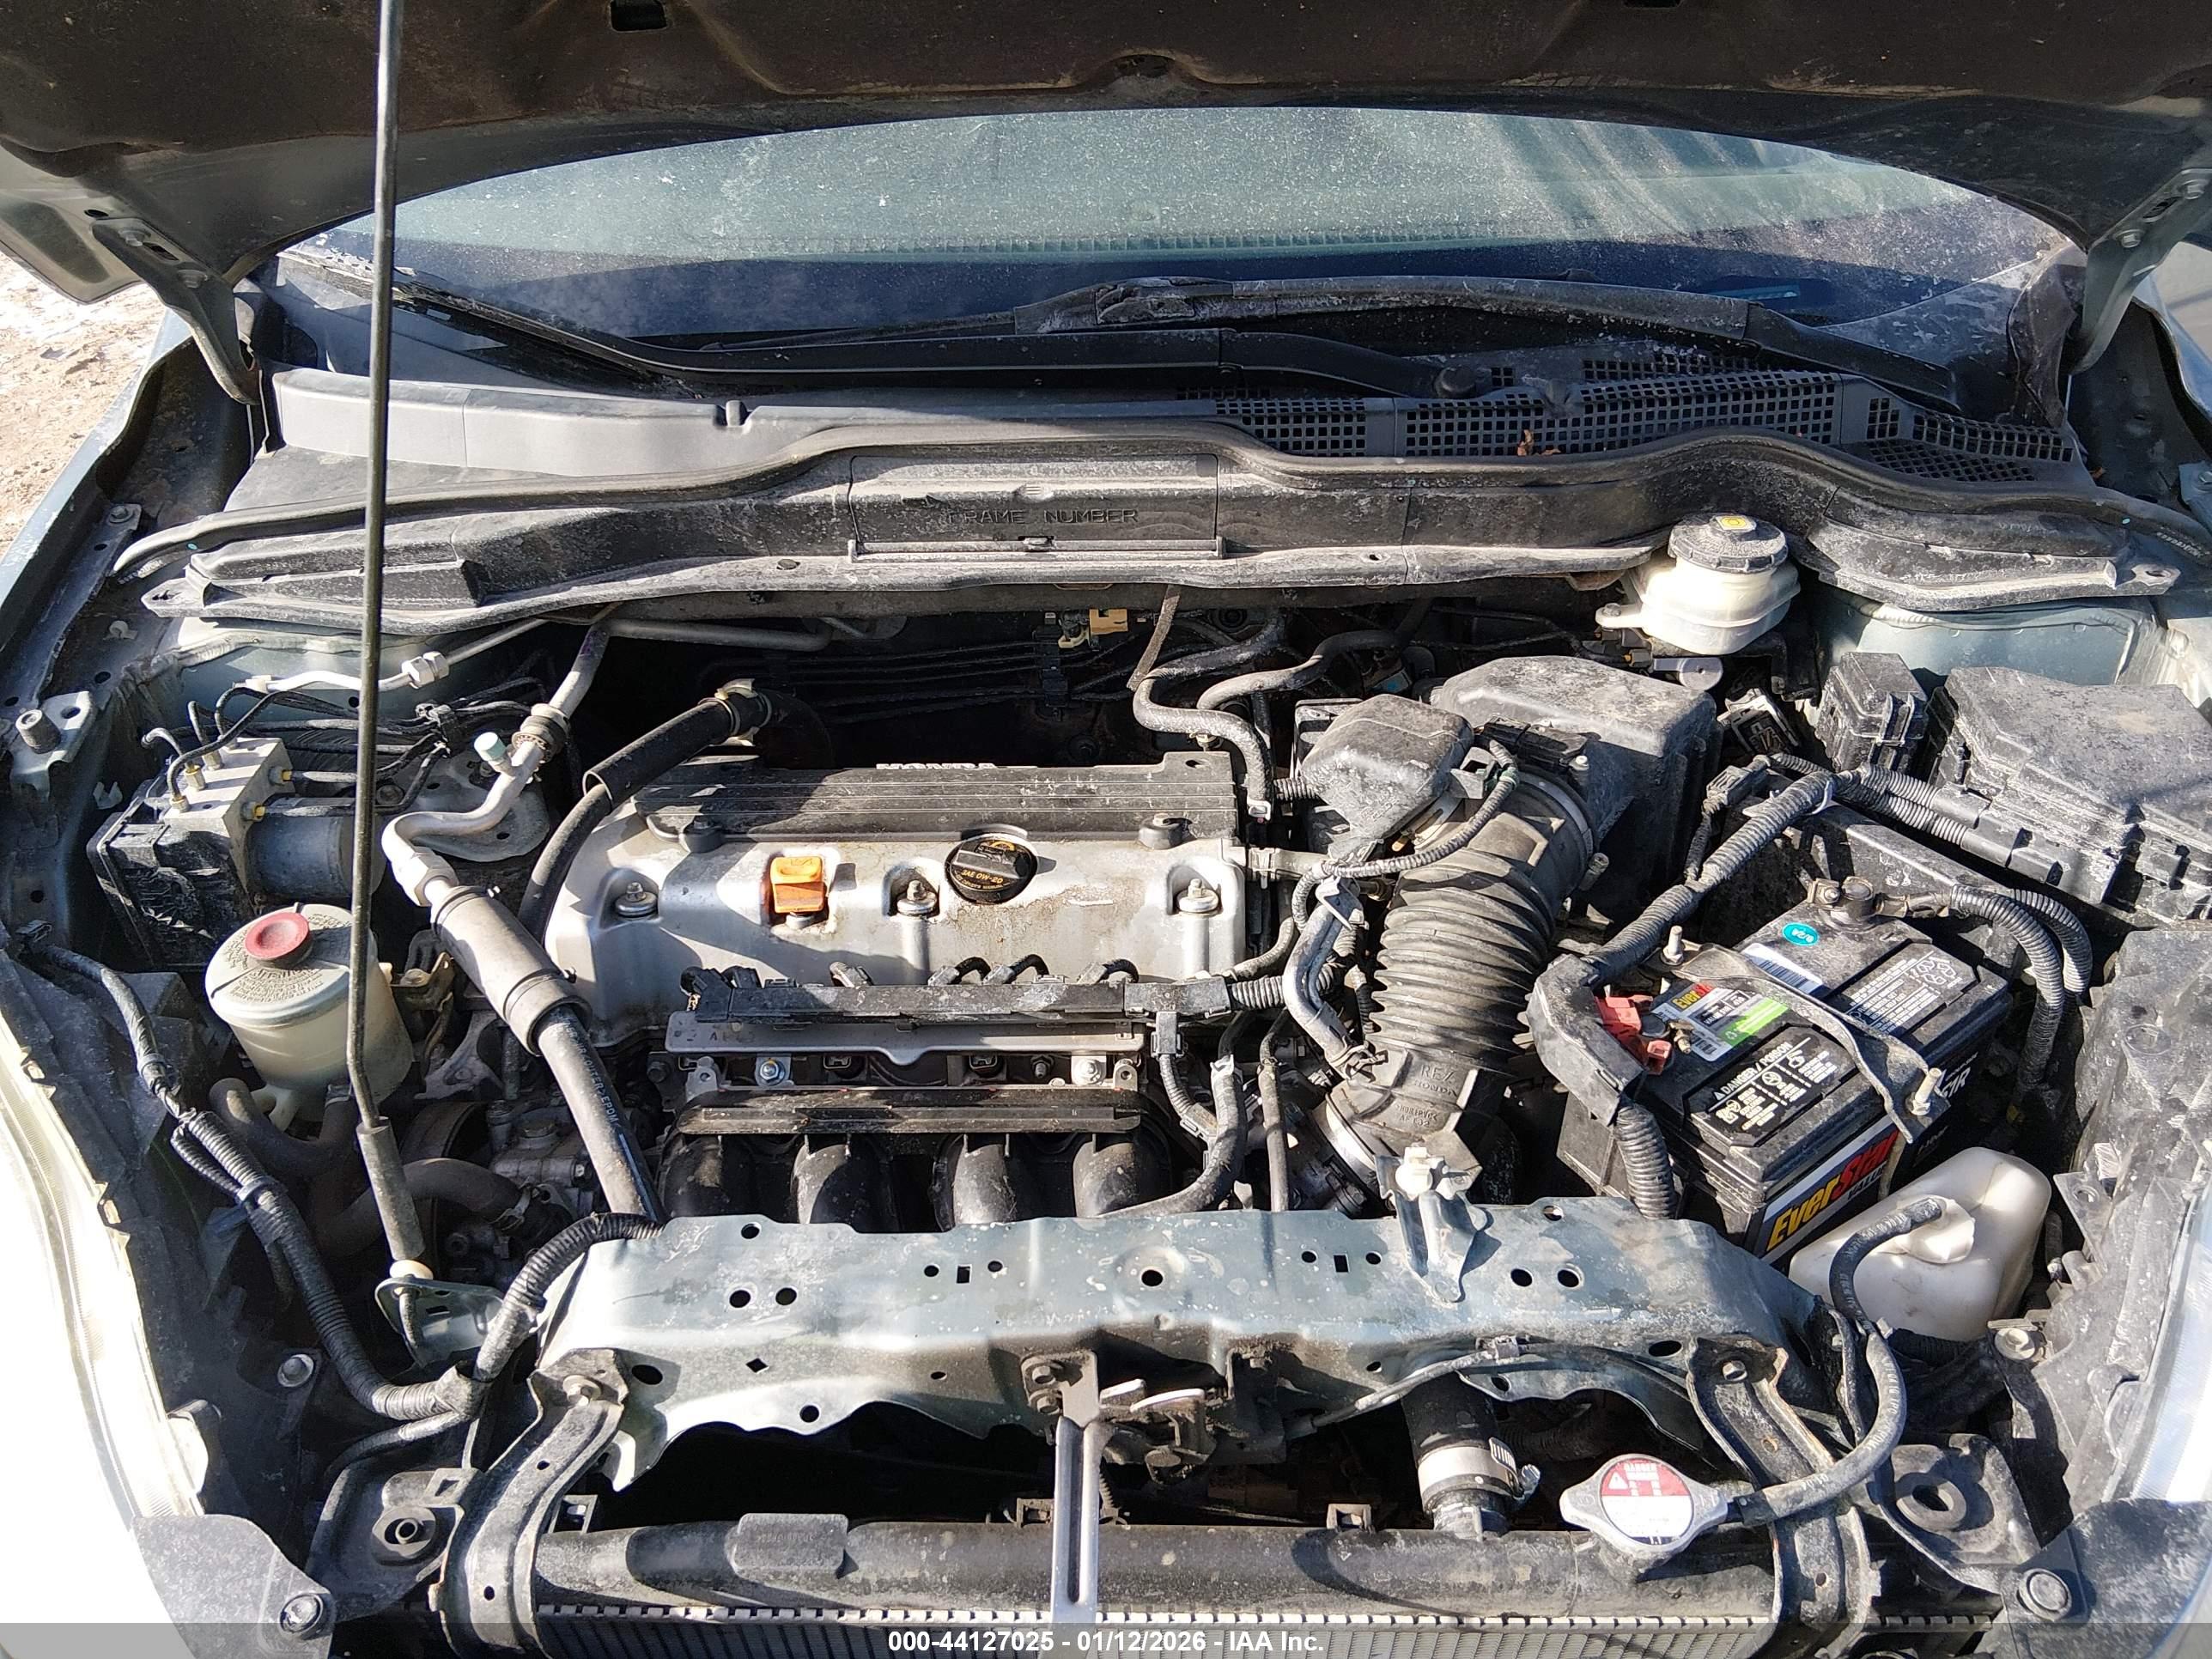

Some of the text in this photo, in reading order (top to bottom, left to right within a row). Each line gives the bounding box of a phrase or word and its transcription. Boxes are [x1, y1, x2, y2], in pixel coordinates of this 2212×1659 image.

[1042, 508, 1139, 525] NUMBER
[1720, 1066, 1758, 1094] DANGER
[1759, 1042, 1794, 1067] POISON
[1766, 1129, 1900, 1252] EverStar
